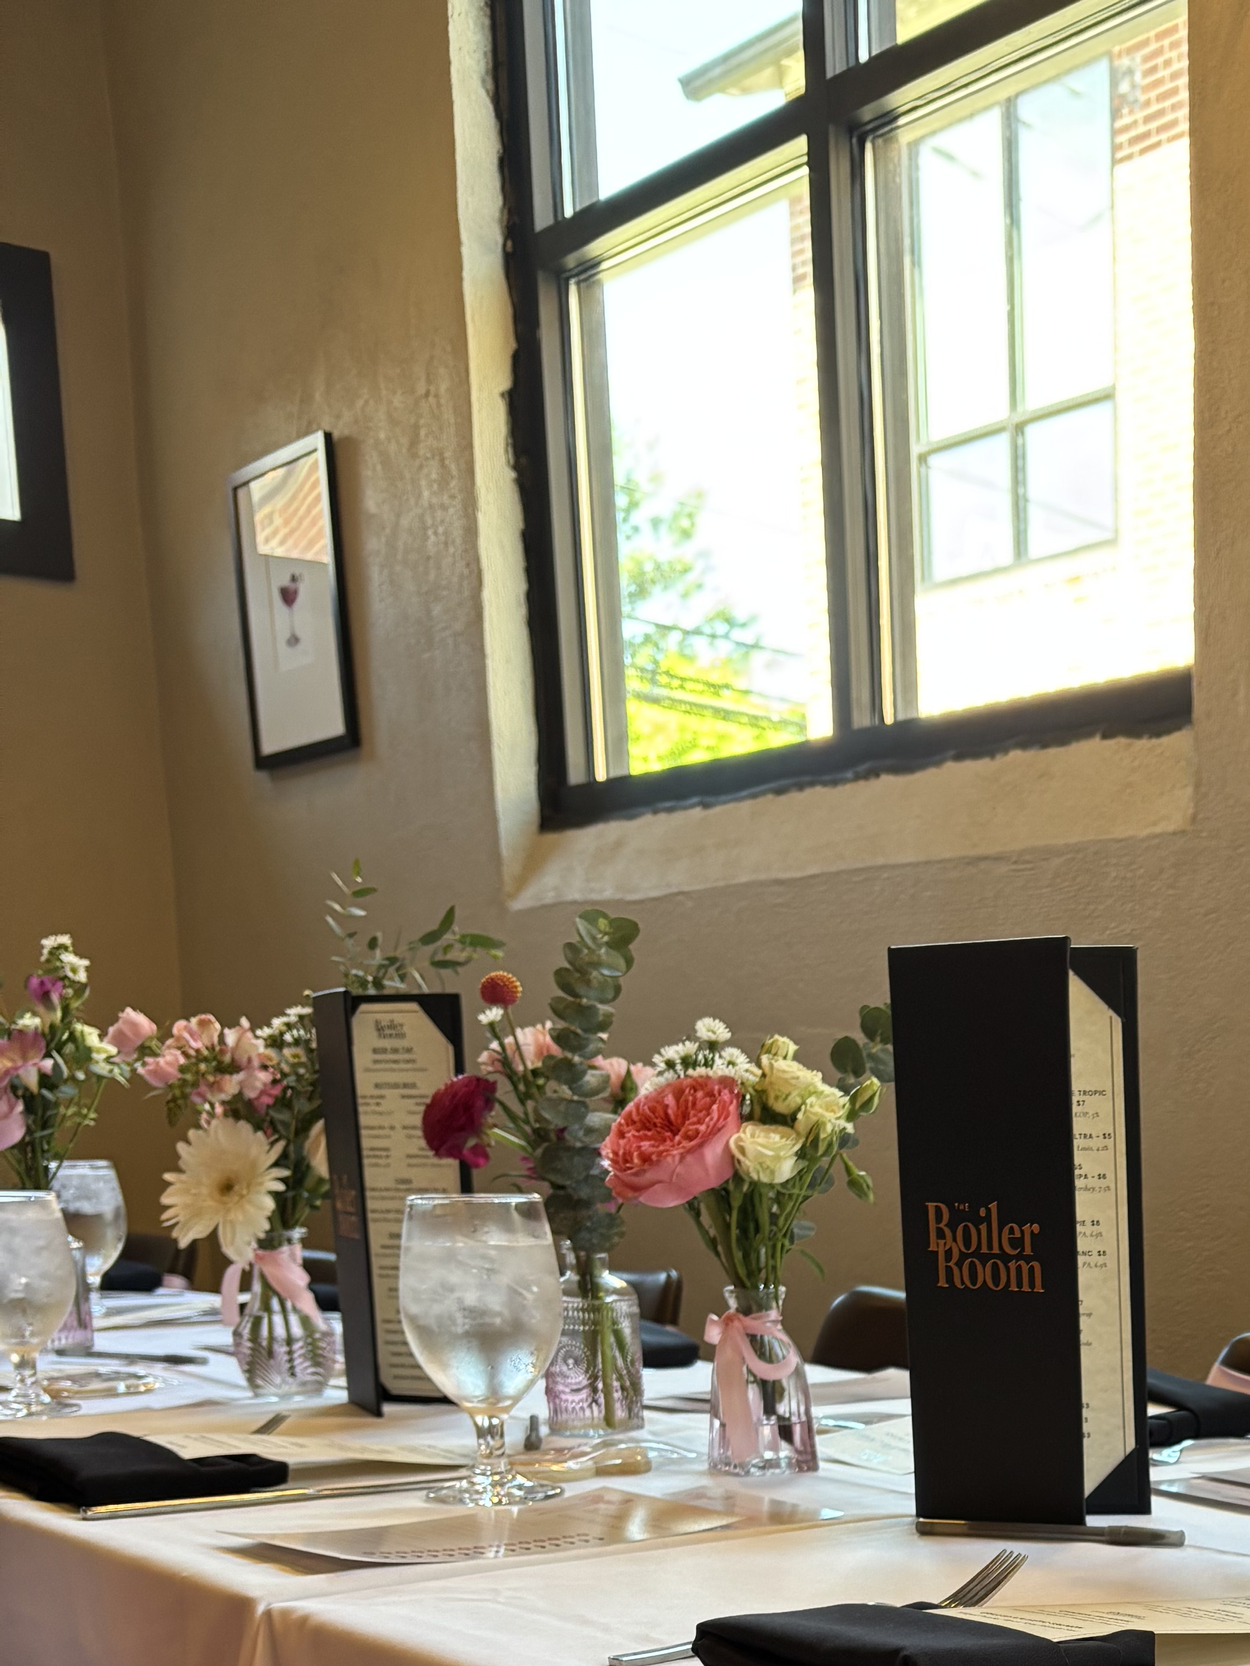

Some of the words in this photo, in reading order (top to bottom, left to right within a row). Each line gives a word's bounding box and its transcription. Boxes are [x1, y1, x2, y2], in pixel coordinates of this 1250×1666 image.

[1077, 1089, 1107, 1097] TROPIC
[925, 1201, 1040, 1255] Boiler
[937, 1240, 1045, 1292] Room
